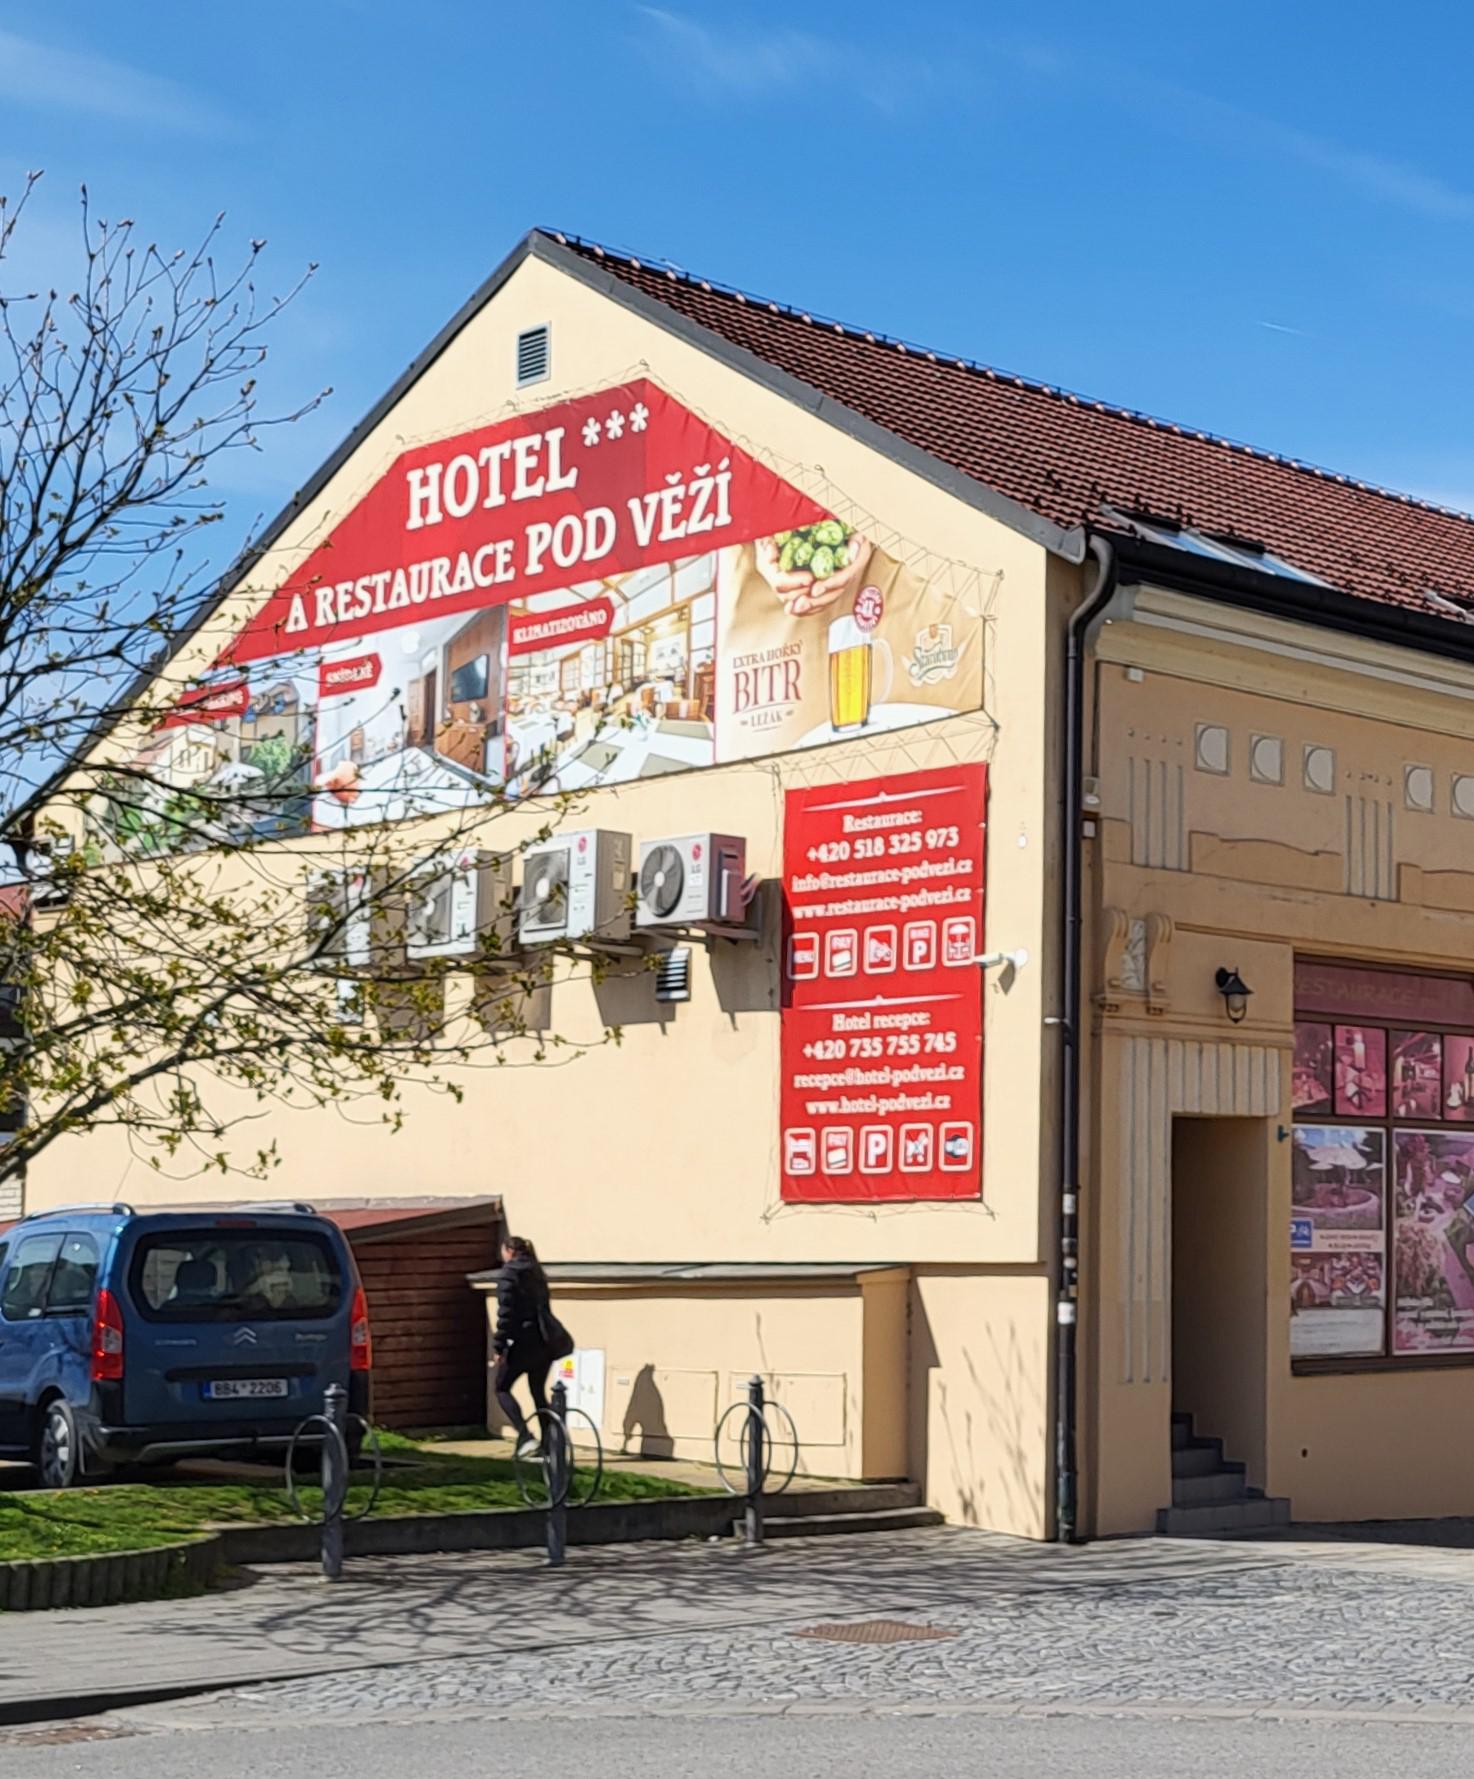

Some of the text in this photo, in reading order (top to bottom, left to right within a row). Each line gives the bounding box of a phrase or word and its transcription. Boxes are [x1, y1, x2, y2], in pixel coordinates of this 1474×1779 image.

[405, 426, 579, 530] HOTEL
[285, 457, 732, 633] A RESTAURACE POD VĚŽÍ
[733, 652, 766, 669] EXTRA
[733, 659, 802, 714] BITR
[843, 810, 922, 833] Restaurace:
[807, 826, 959, 863] +420 518 325 973
[792, 857, 973, 892] info@restaurace-podvezi.cz
[792, 885, 972, 919] www.restaurace-podvezi.cz
[832, 1012, 931, 1031] Hotel recepce:
[802, 1031, 957, 1060] +420 735 755 745
[793, 1062, 965, 1091] recepce@hotel-podvezi.cz
[806, 1092, 951, 1116] www.hotel-podvezi.cz
